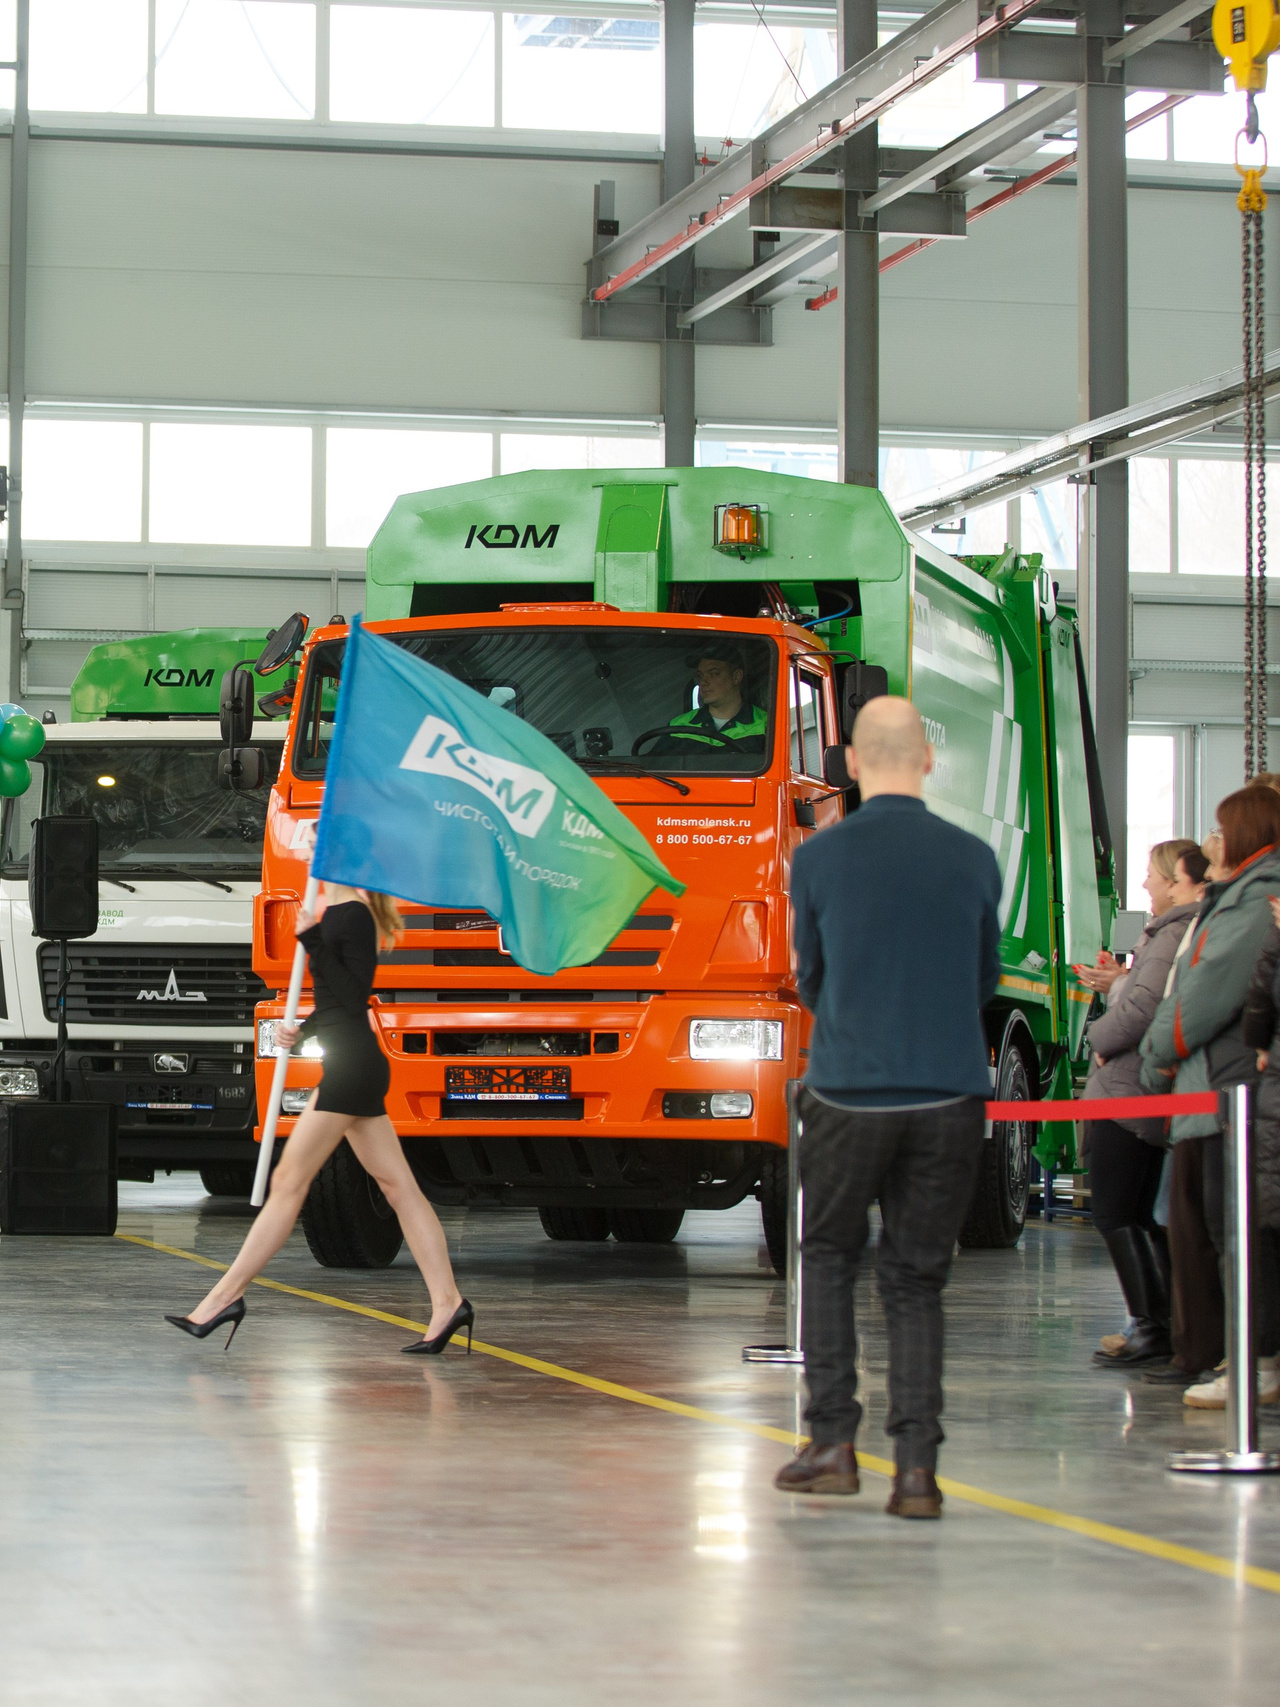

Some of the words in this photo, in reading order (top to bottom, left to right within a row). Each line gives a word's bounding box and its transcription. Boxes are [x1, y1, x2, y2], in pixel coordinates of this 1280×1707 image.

[464, 524, 560, 549] KDM
[143, 668, 216, 687] KDM
[656, 817, 751, 828] kdmsmolensk.ru
[656, 834, 664, 844] 8
[667, 834, 689, 845] 800
[692, 834, 753, 846] 500-67-67
